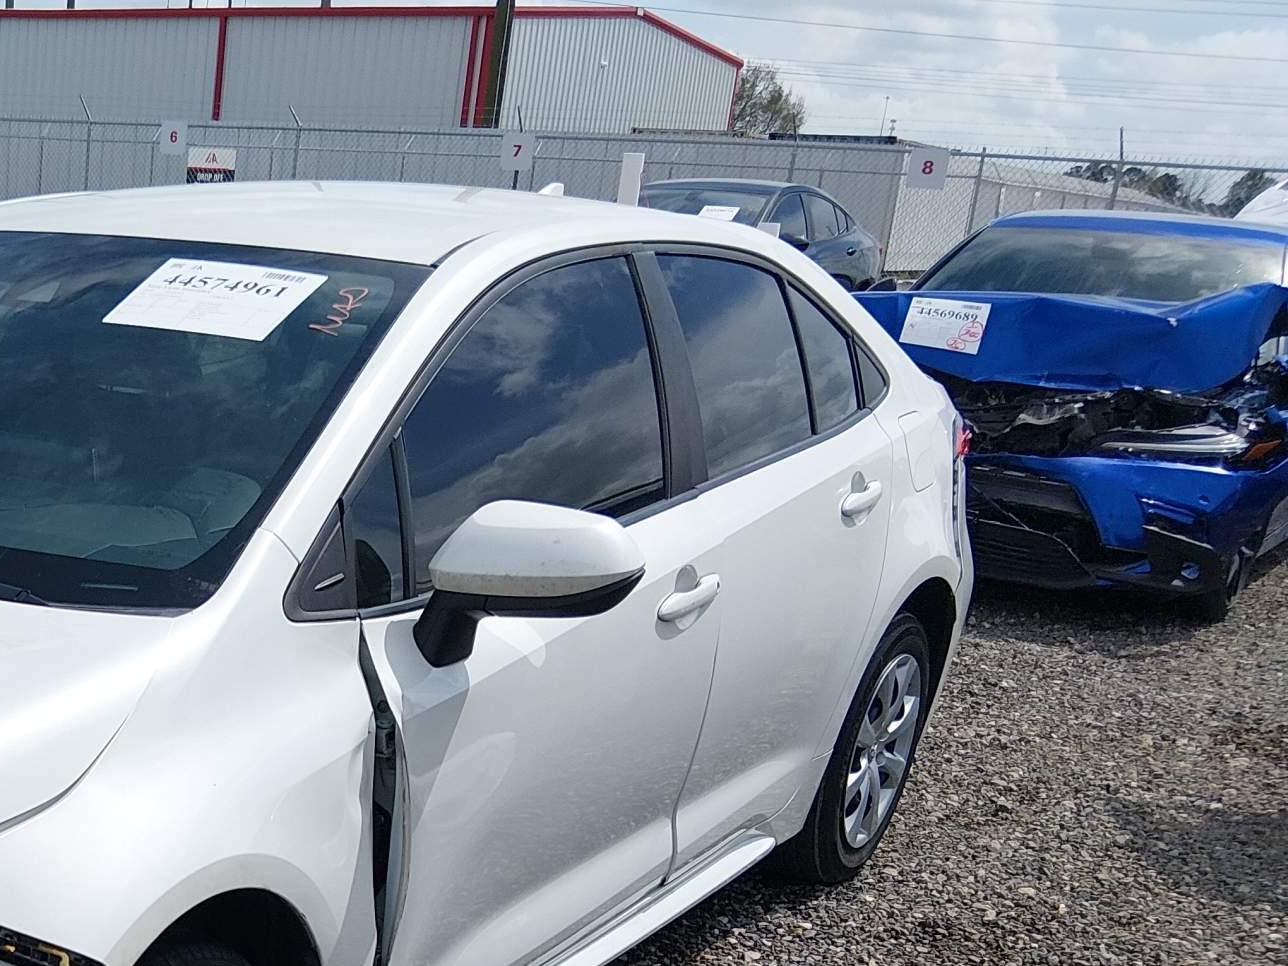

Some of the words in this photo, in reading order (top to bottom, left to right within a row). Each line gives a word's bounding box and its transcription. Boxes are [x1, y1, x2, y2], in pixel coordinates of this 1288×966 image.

[169, 130, 179, 143] 6
[513, 144, 523, 157] 7
[921, 160, 934, 175] 8
[163, 274, 288, 297] 44574961
[918, 306, 979, 322] 44569689
